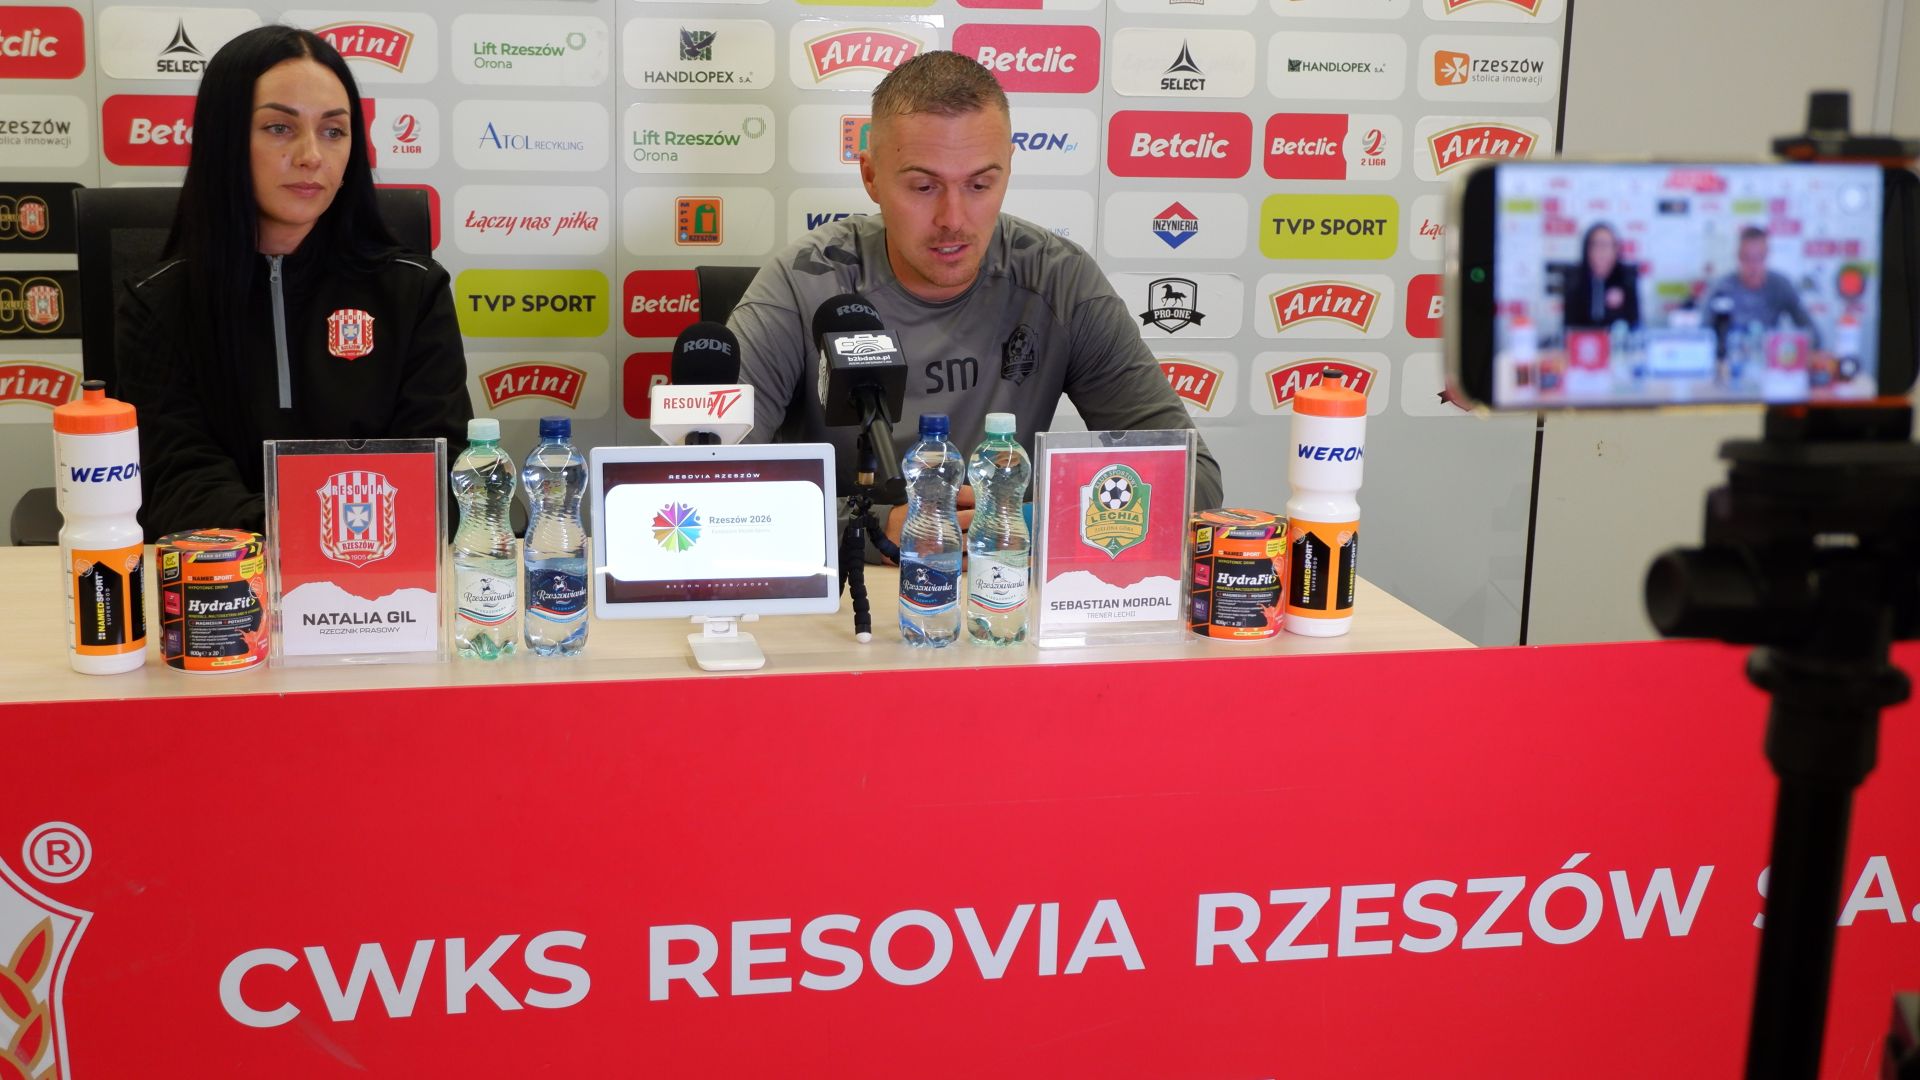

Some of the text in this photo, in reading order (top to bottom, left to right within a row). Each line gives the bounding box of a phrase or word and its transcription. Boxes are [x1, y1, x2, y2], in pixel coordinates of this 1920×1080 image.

[0, 28, 59, 57] clic
[474, 41, 565, 57] Lift Rzeszów
[157, 60, 207, 73] SELECT
[474, 57, 513, 69] Orona
[977, 46, 1077, 73] Betclic
[1303, 61, 1371, 73] HANDLOPEX
[1472, 58, 1544, 73] rzeszów
[644, 71, 734, 83] HANDLOPEX
[1161, 78, 1205, 91] SELECT
[1472, 74, 1543, 86] stolica innowacji
[0, 118, 71, 135] zeszów
[25, 136, 71, 148] innowacji
[479, 121, 584, 151] ATOL RECYKLING
[633, 130, 741, 147] Lift Rzeszów
[393, 145, 422, 154] 2 LIGA
[1131, 132, 1230, 159] Betclic
[1271, 137, 1337, 155] Betclic
[1442, 130, 1524, 164] Arini
[633, 148, 678, 162] Orona
[1361, 158, 1386, 166] 2 LIGA
[464, 210, 599, 236] Łączy nas piłka
[1273, 218, 1387, 236] TVP SPORT
[468, 294, 596, 313] TVP SPORT
[630, 294, 700, 314] Betclic
[1284, 288, 1366, 321] Arini
[1154, 309, 1192, 320] PRO-ONE
[683, 338, 732, 356] RØDE
[0, 369, 65, 399] rini
[495, 368, 574, 400] Arini
[663, 388, 742, 419] RESOVIA TV
[332, 484, 384, 495] RESOVIA
[709, 514, 772, 525] Rzeszów 2026
[1091, 511, 1140, 523] LECHIA
[342, 540, 375, 550] RZESZÓW
[1303, 543, 1313, 596] NAMEDSPORT
[1216, 573, 1273, 587] HydraFit
[95, 573, 106, 632] NAMEDSPORT
[188, 597, 251, 614] HydraFit
[1051, 596, 1172, 611] SEBASTIAN MORDAL
[303, 611, 416, 626] NATALIA GIL
[360, 626, 400, 634] PRASOWY
[218, 930, 591, 1028] CWKS
[649, 899, 1145, 1001] RESOVIA
[1195, 852, 1715, 966] RZESZÓW
